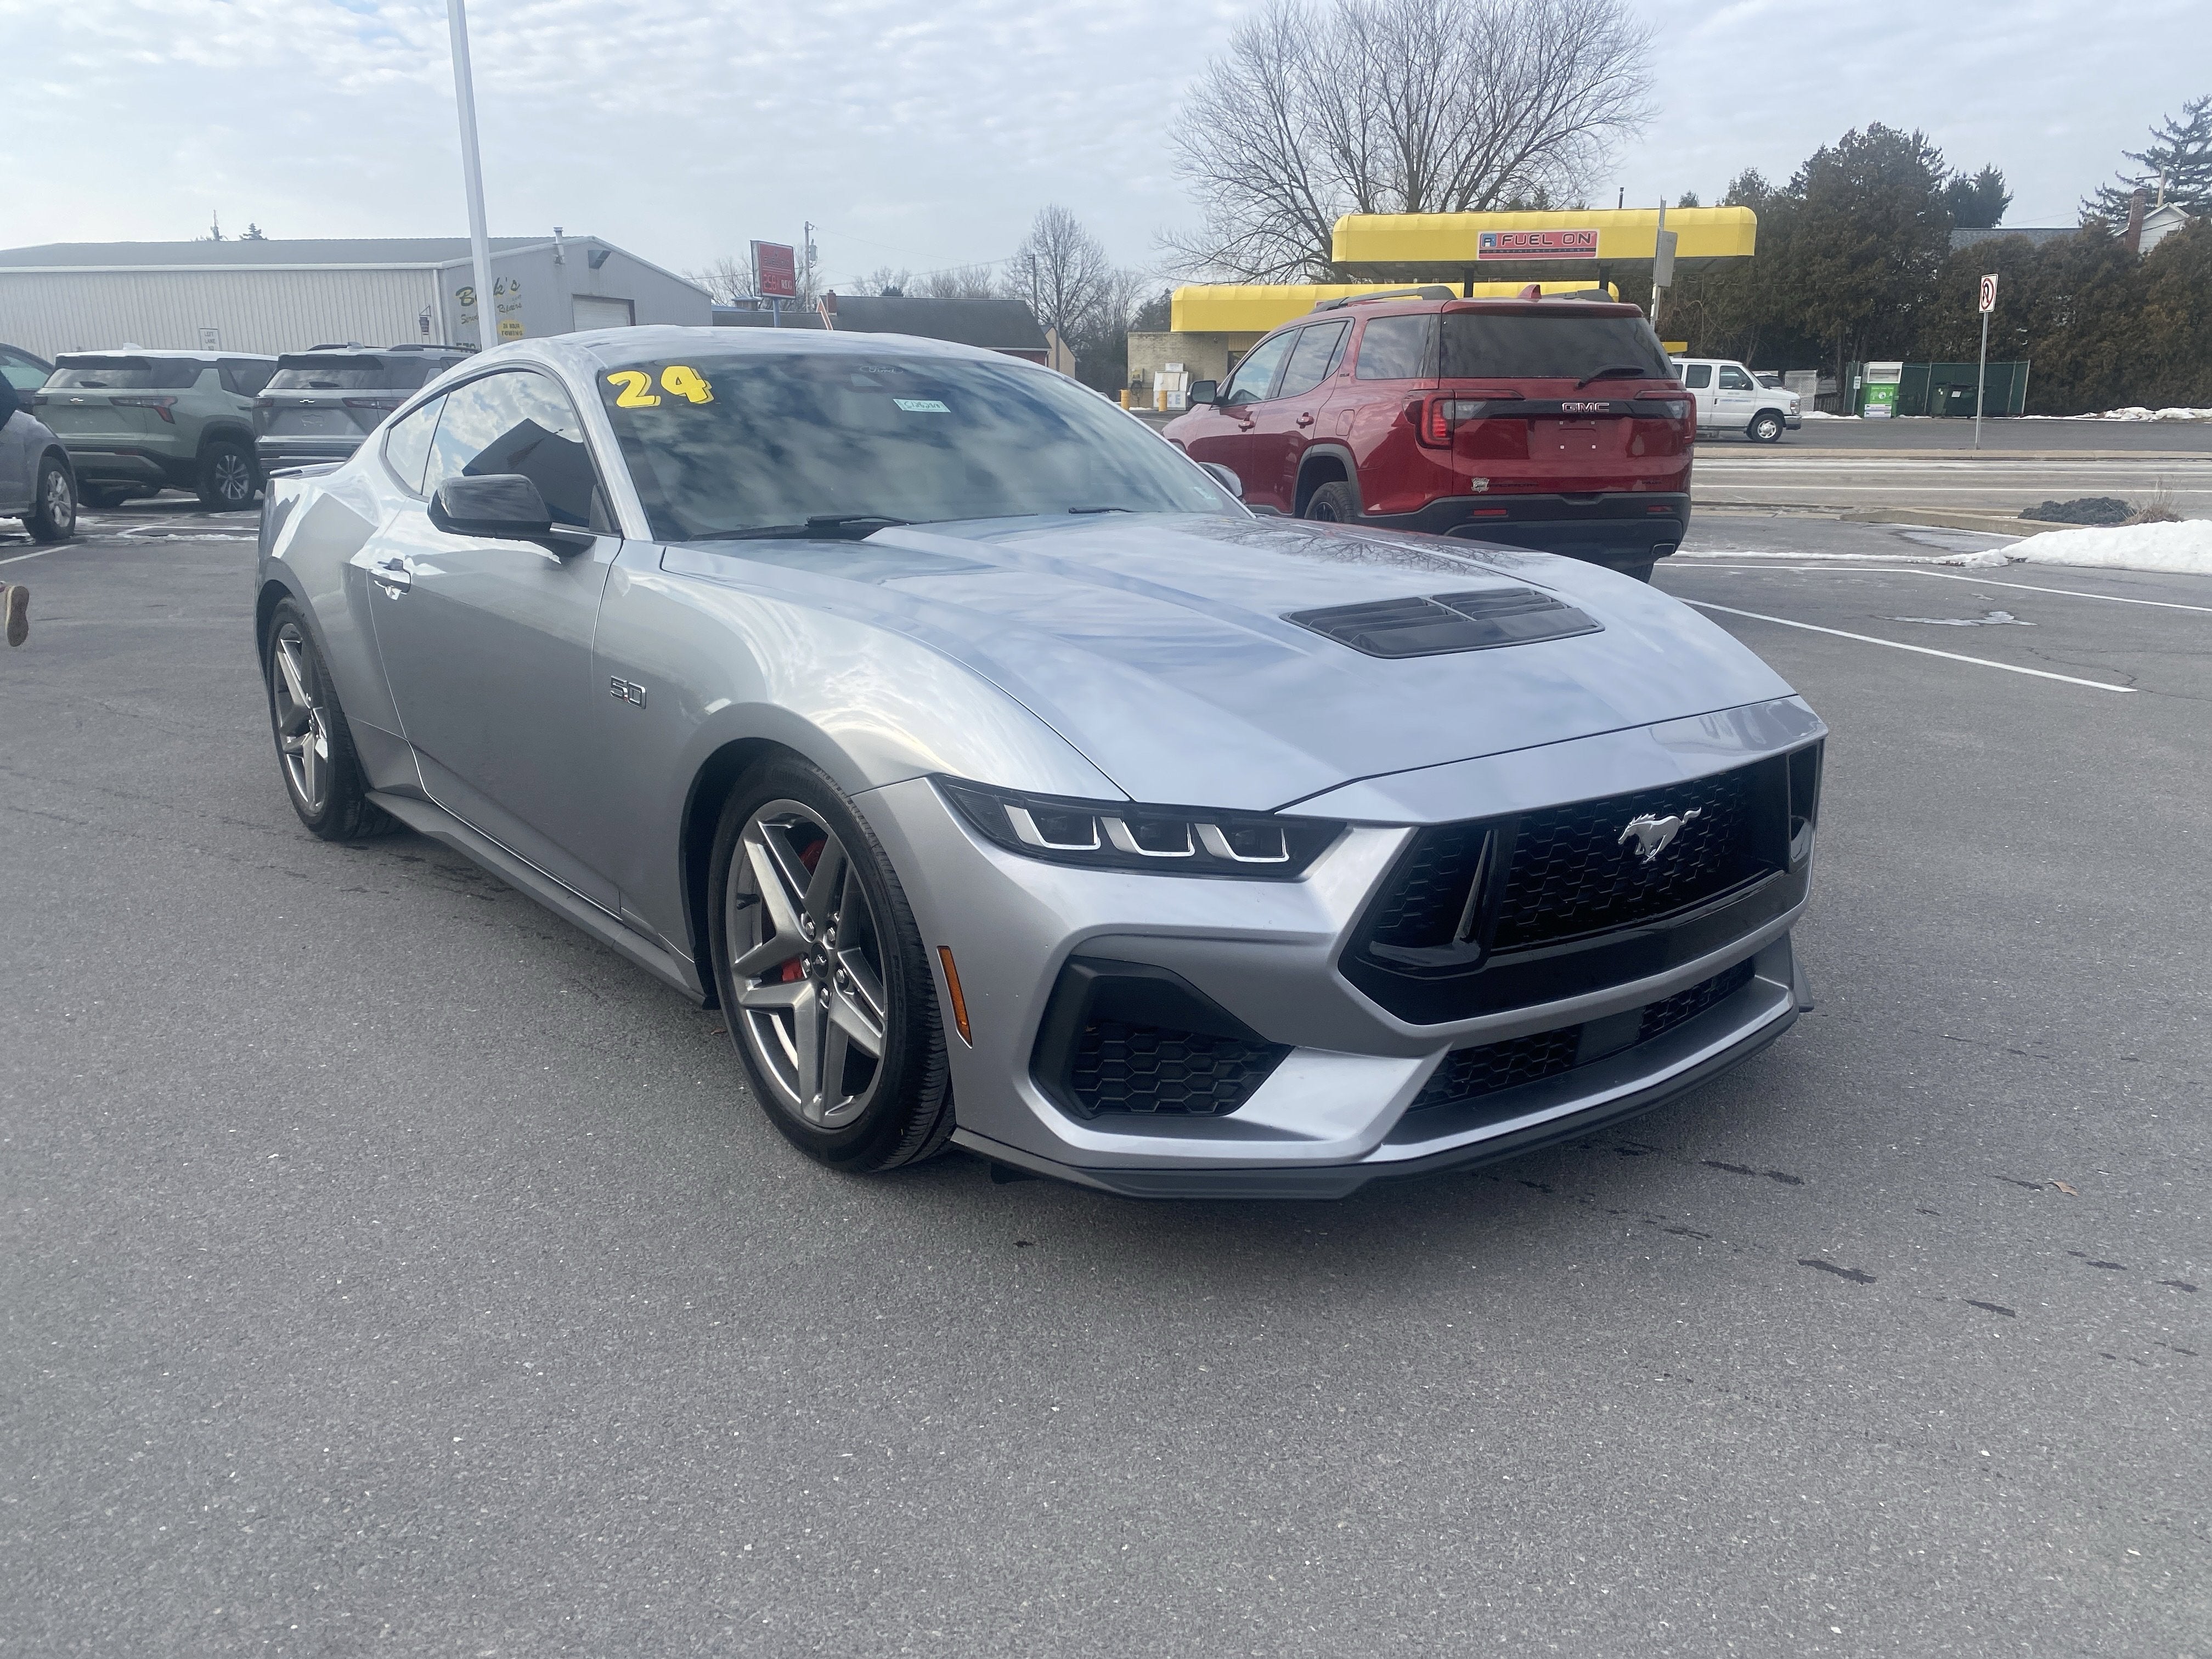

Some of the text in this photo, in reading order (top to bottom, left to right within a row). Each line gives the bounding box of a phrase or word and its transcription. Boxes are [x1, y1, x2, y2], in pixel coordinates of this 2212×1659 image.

[1502, 232, 1592, 246] FUEL ON
[606, 365, 714, 409] 24
[1561, 402, 1610, 413] GMC
